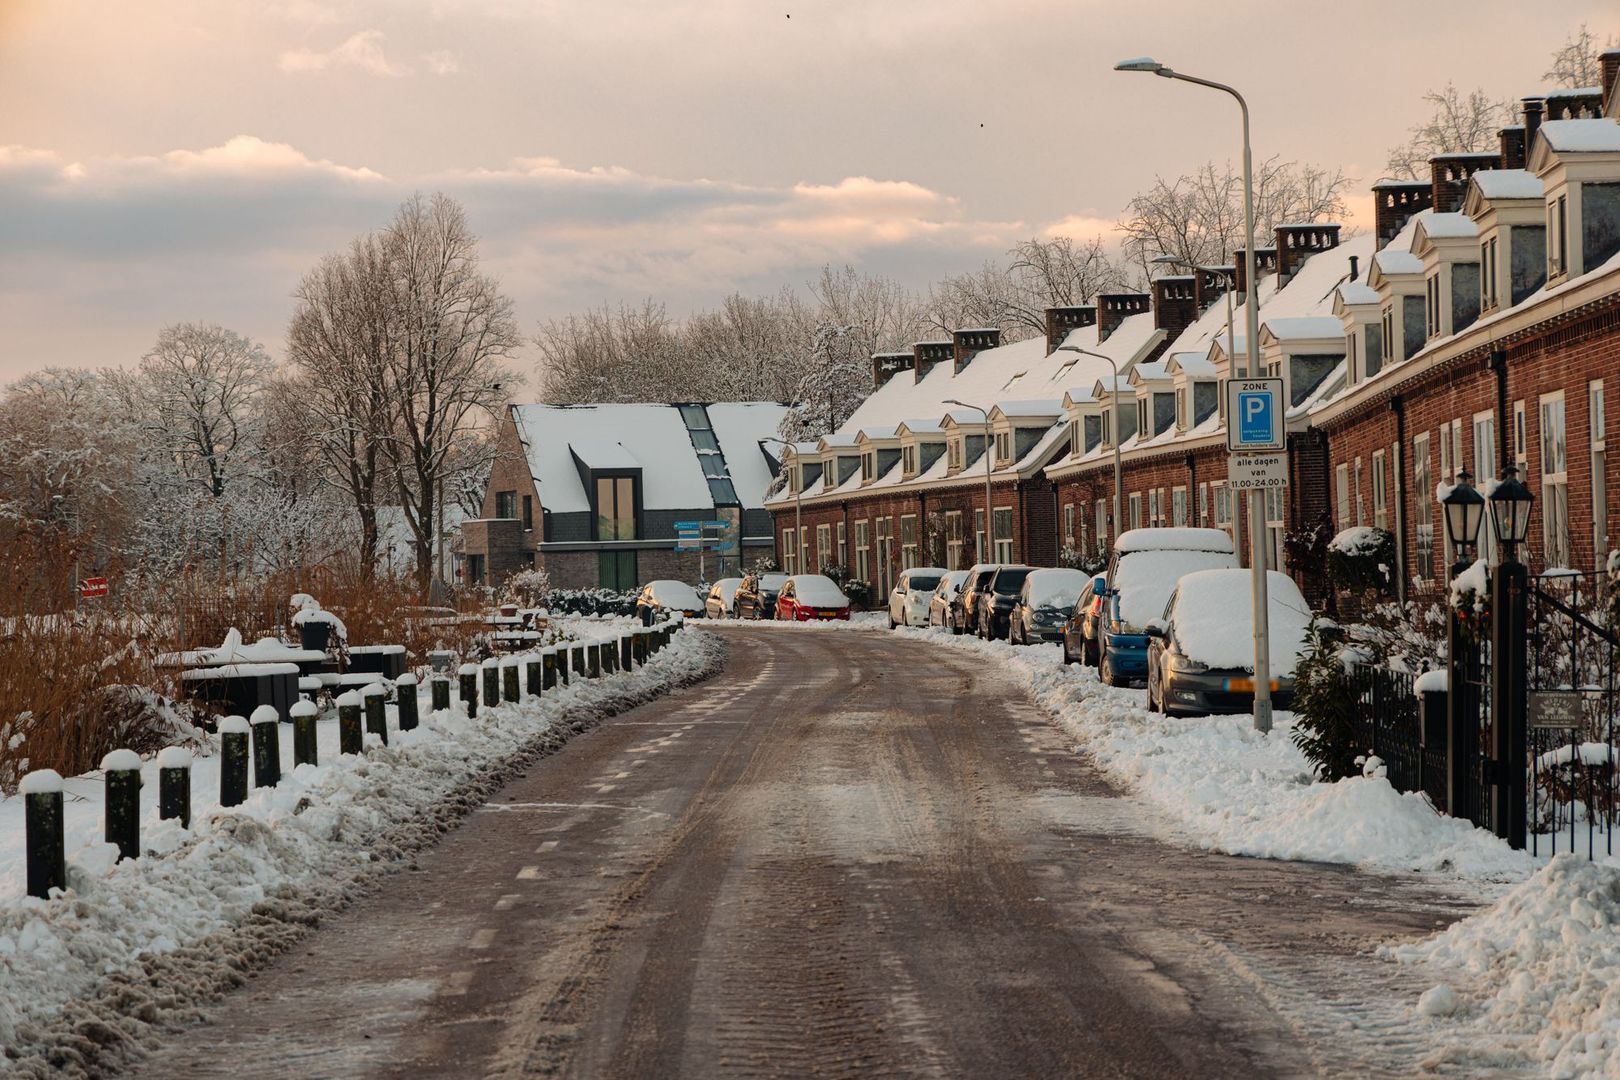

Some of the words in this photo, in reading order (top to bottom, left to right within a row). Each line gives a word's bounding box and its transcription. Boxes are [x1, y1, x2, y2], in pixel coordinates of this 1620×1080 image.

[1246, 397, 1265, 423] P
[1237, 458, 1252, 466] alle
[1254, 457, 1279, 467] dagen
[1231, 479, 1279, 488] 11.00-24.00
[1281, 478, 1287, 486] h
